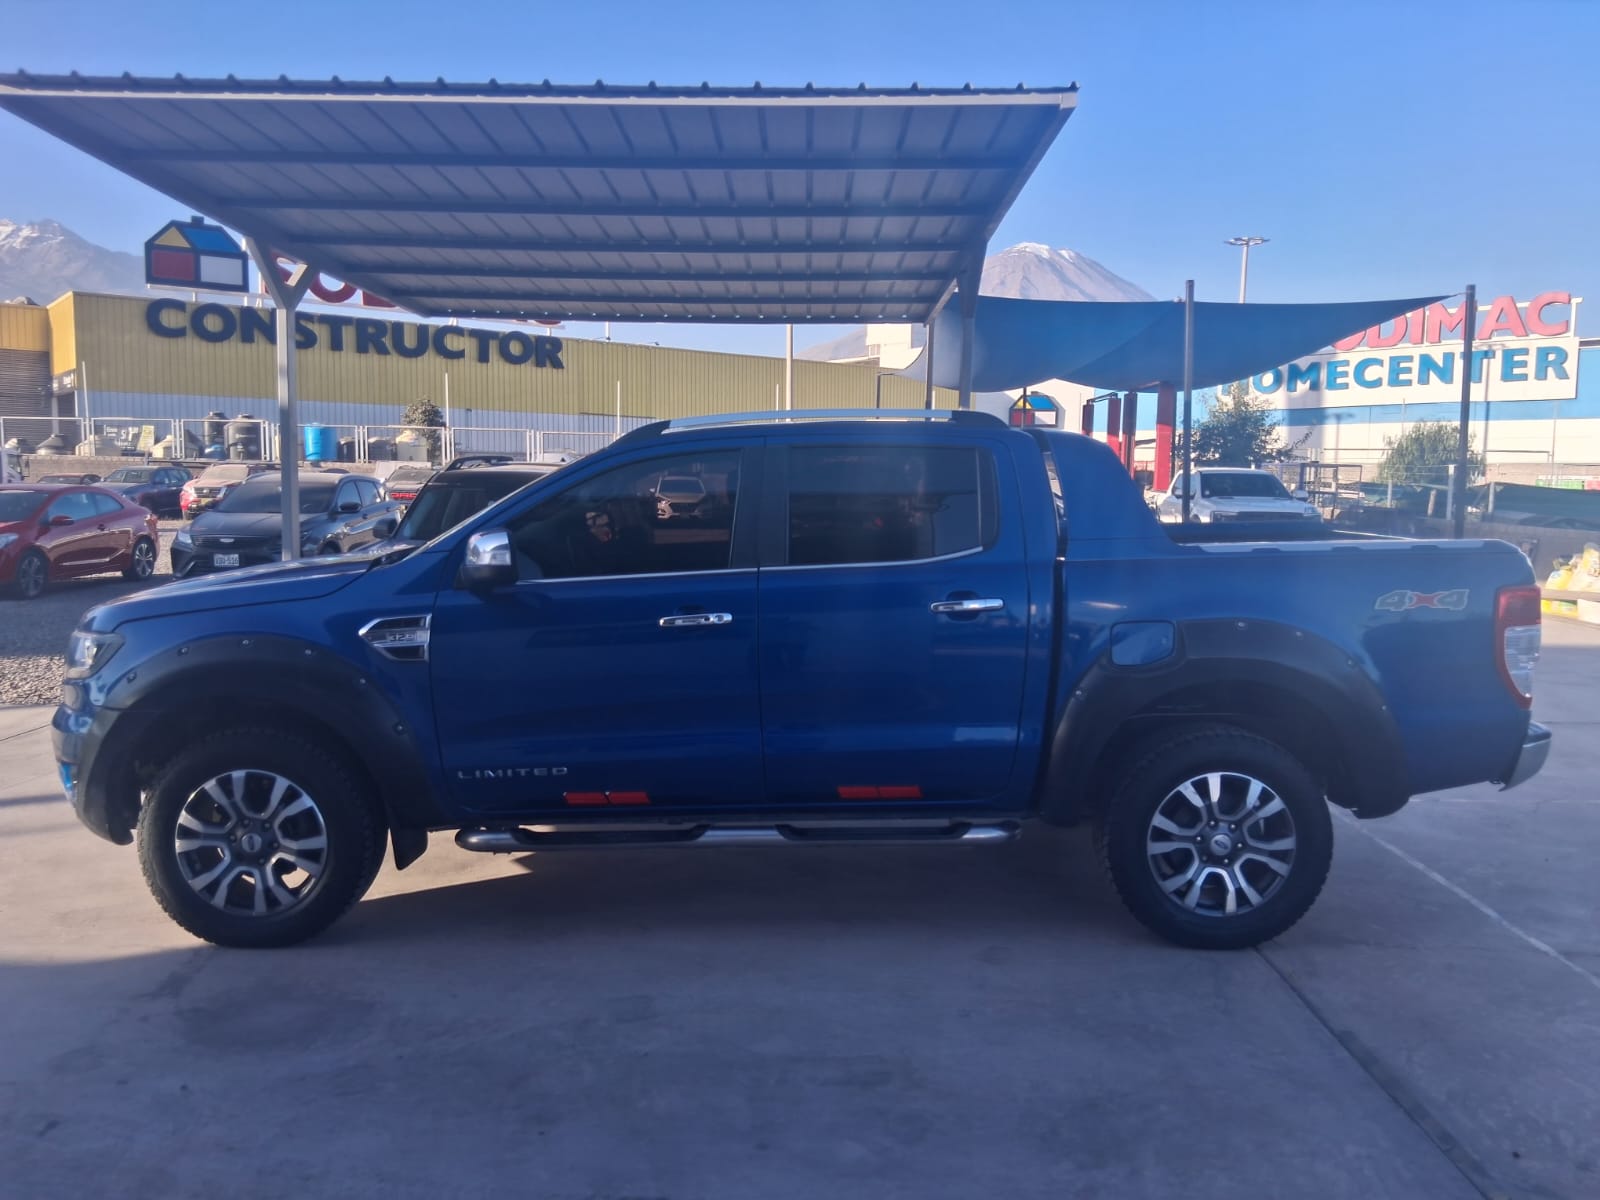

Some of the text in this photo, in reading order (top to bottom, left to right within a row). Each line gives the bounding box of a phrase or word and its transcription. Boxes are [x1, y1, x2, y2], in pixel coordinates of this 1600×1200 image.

[146, 297, 565, 369] CONSTRUCTOR
[1331, 291, 1572, 351] DIMAC
[457, 767, 568, 779] LIMITED
